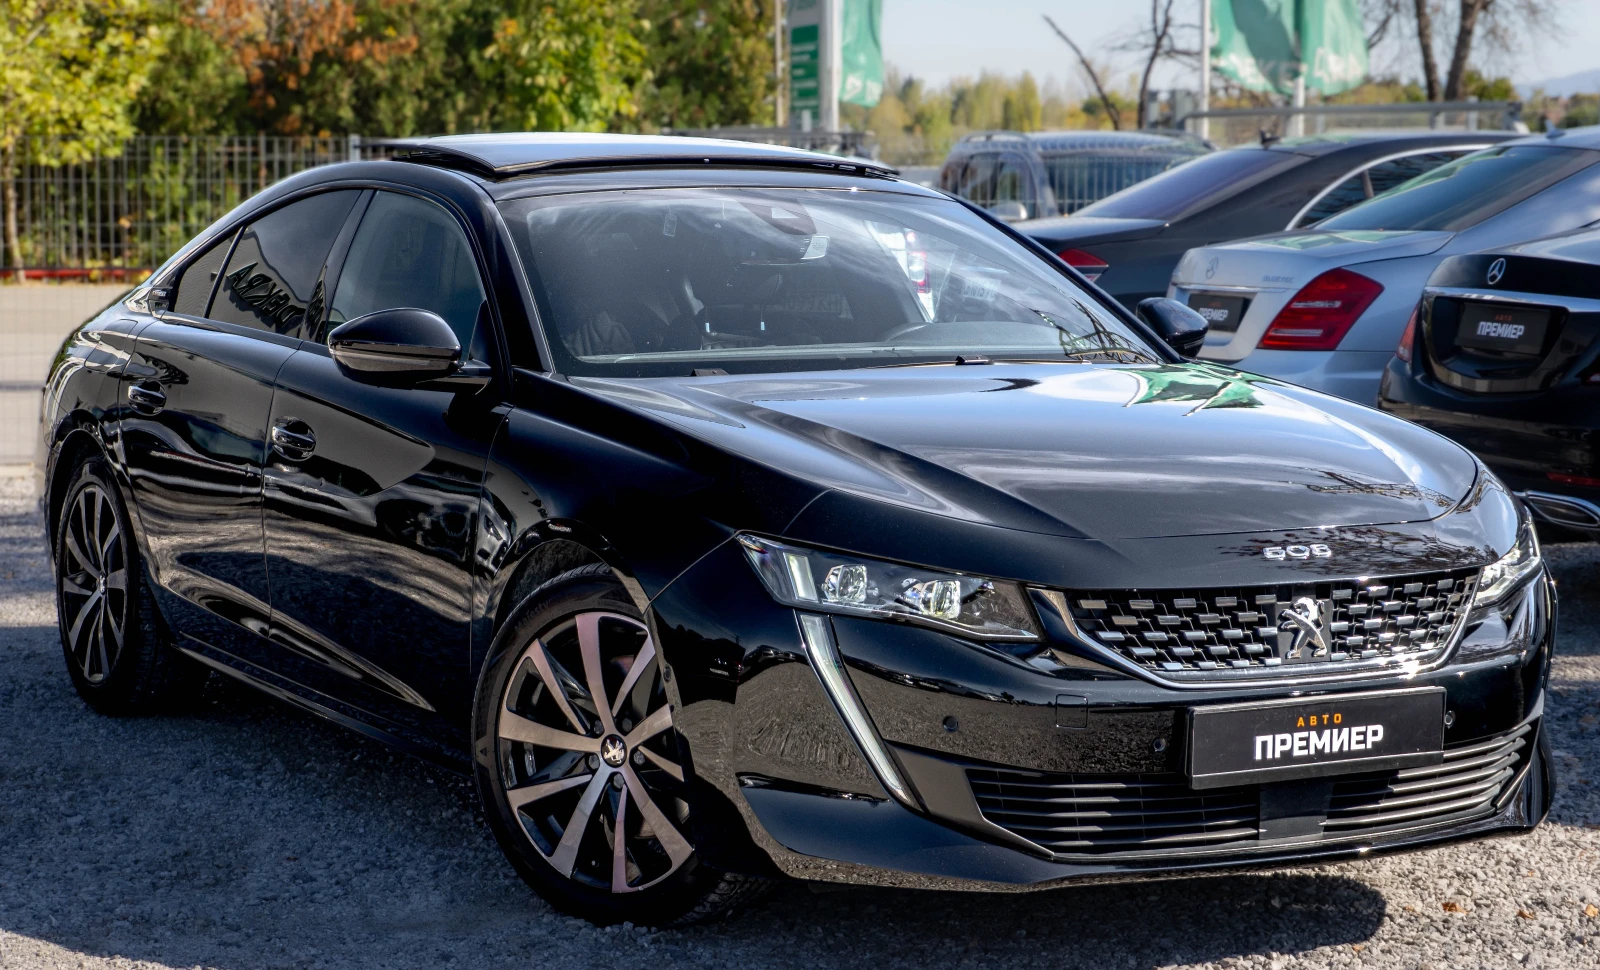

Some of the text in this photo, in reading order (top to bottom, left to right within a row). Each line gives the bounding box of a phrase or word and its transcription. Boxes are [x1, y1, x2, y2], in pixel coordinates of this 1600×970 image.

[1477, 321, 1525, 339] ПРЕМИЕР
[1263, 543, 1332, 561] 508
[1297, 713, 1342, 728] АВТО
[1254, 724, 1384, 761] ПРЕМИЕР
